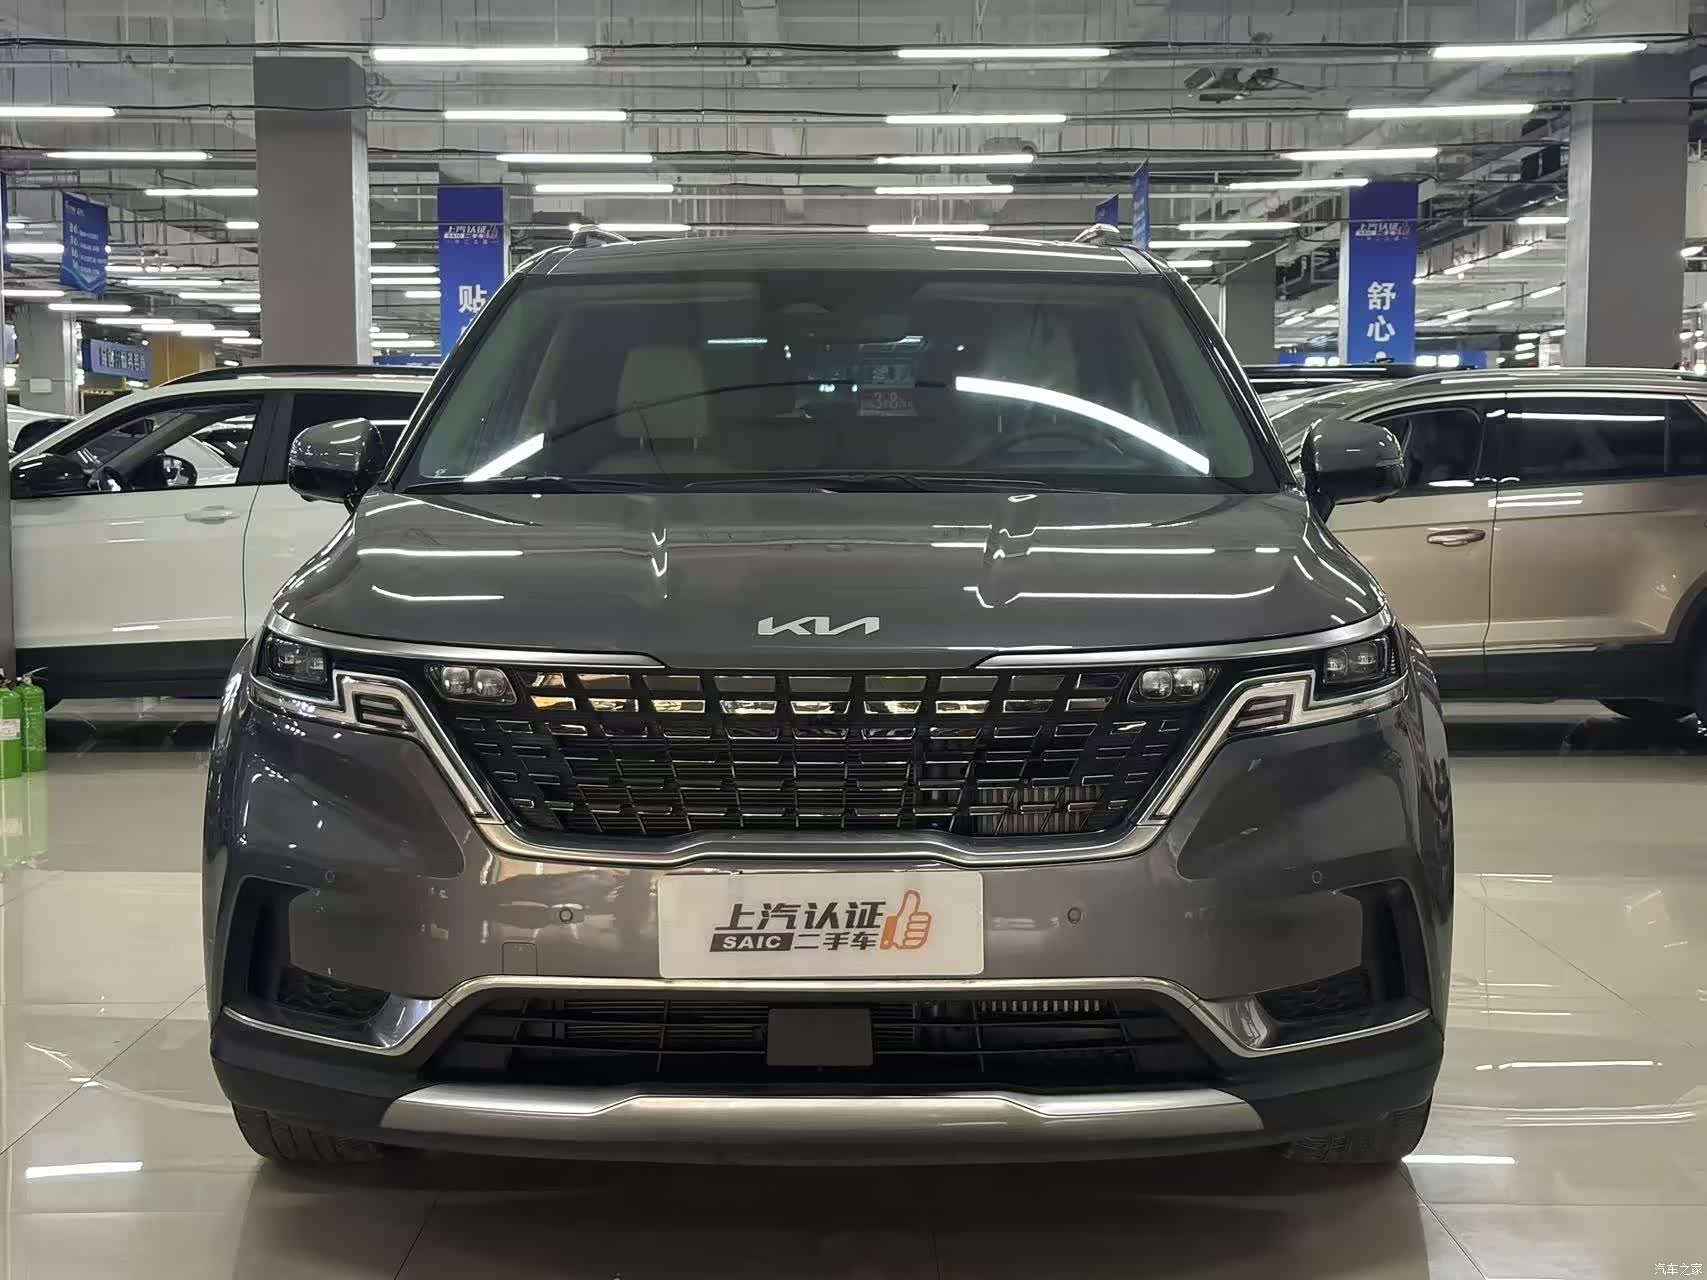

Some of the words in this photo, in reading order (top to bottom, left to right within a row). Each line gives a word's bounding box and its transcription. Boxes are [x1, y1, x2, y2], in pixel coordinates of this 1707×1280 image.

[1366, 281, 1396, 361] 舒心
[758, 616, 880, 635] KIA
[715, 901, 886, 930] 上汽认证
[722, 934, 784, 949] SAIC
[794, 931, 879, 950] 二手车
